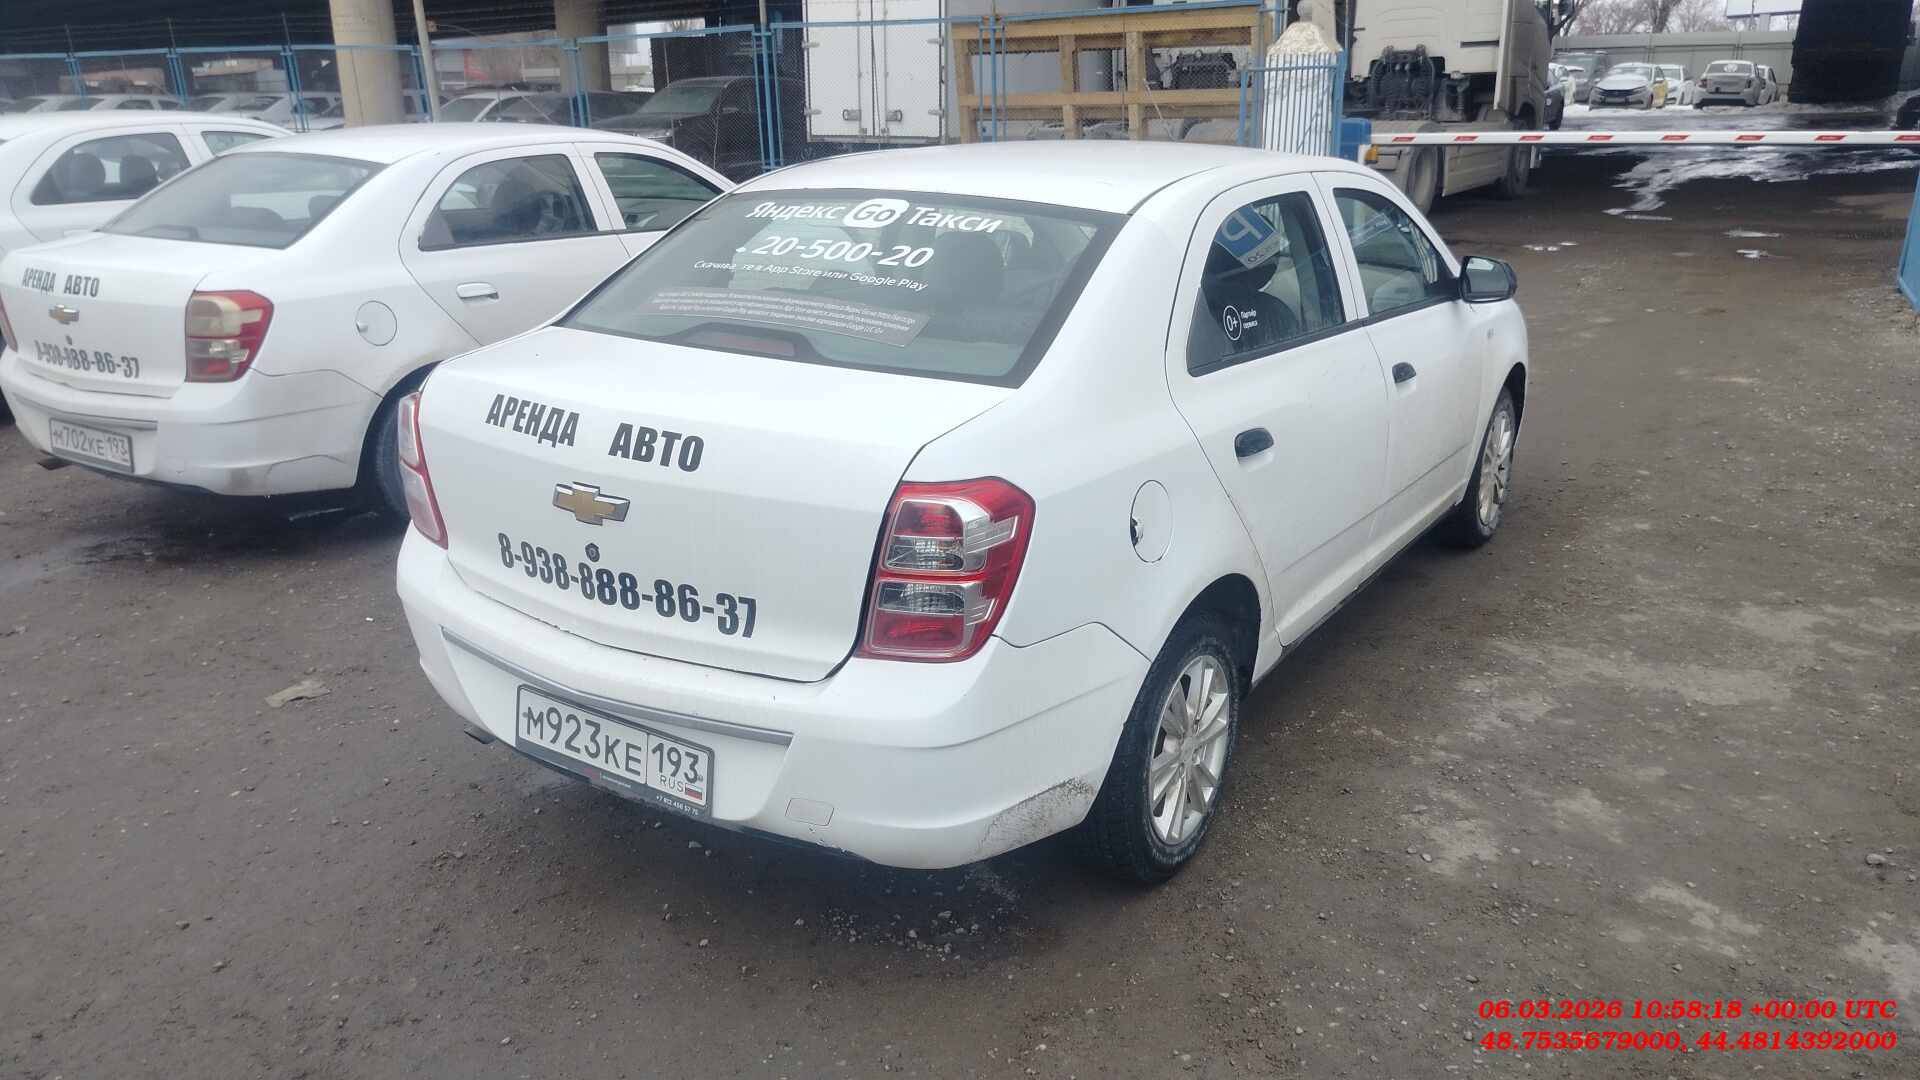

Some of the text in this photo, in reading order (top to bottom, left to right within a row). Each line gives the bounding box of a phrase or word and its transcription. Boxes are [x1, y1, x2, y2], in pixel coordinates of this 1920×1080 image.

[746, 202, 1003, 233] Яндекс Go Такси
[22, 267, 100, 298] АРЕНДА АВТО
[763, 264, 788, 275] App
[789, 266, 821, 277] Store
[823, 271, 847, 279] или
[850, 272, 896, 286] Google
[897, 278, 928, 291] Play
[1226, 315, 1238, 331] 0+
[107, 436, 127, 456] 193
[485, 394, 704, 472] АРЕНДА АВТО
[497, 532, 757, 638] 8-938-888-86-37
[526, 706, 699, 783] М923КЕ 193
[659, 774, 684, 793] RUS
